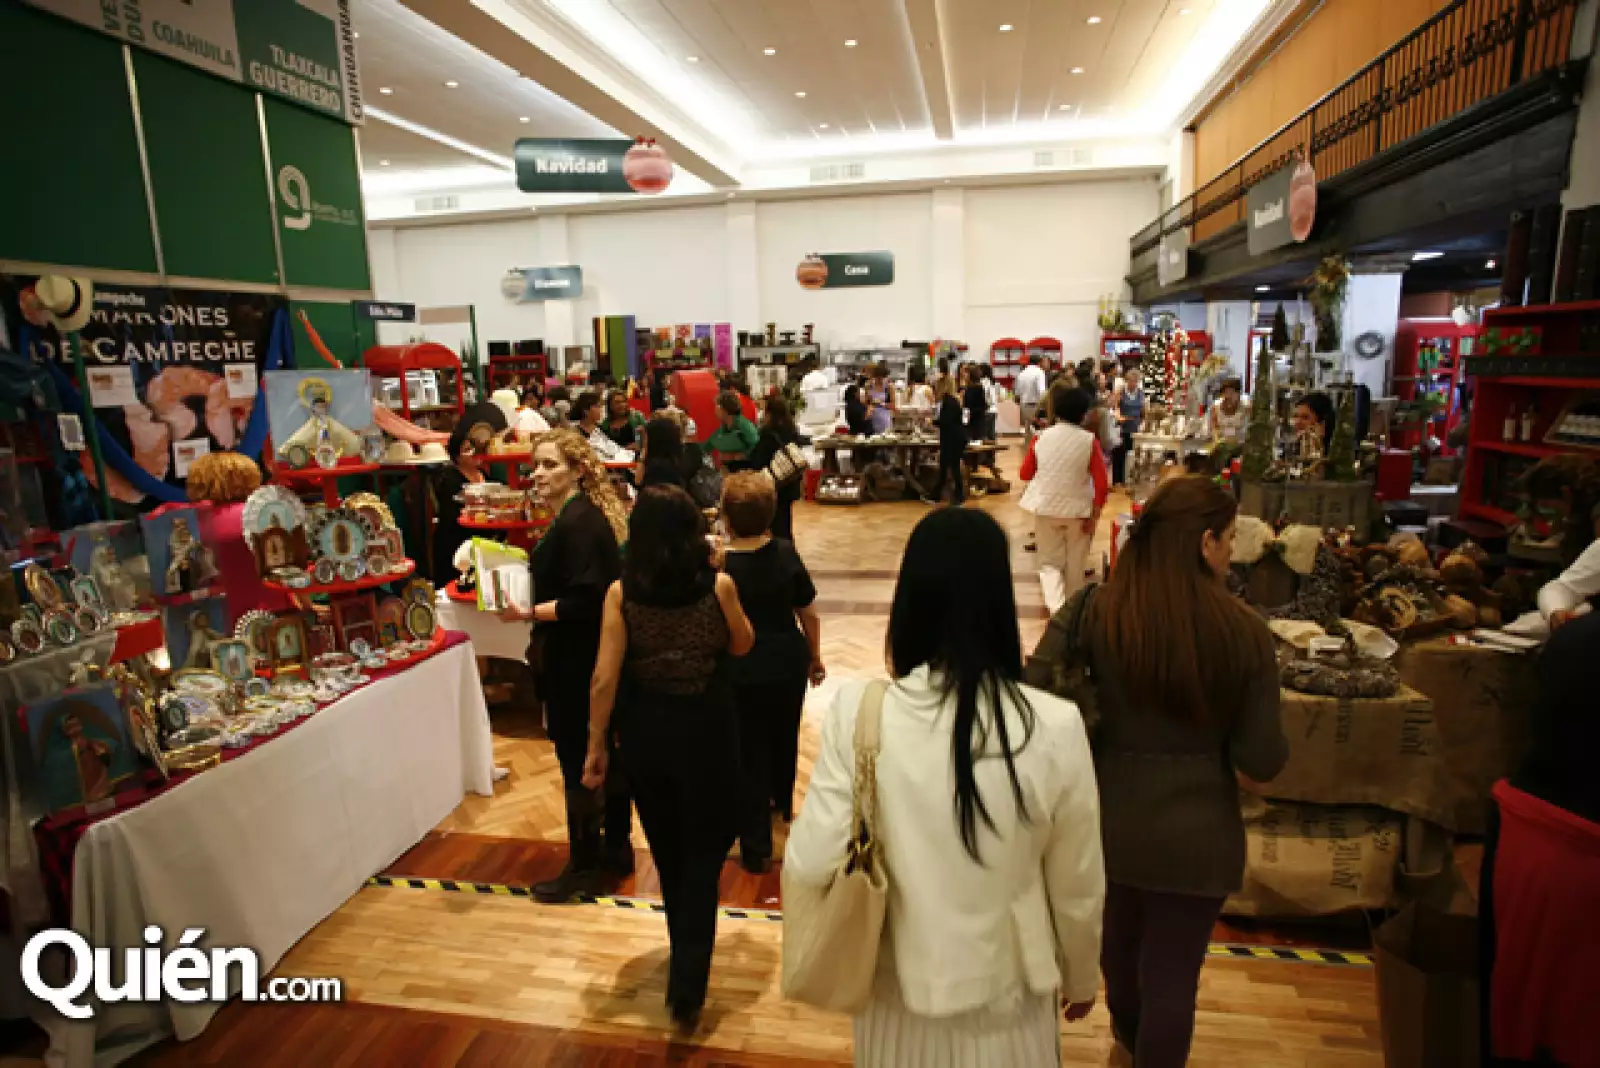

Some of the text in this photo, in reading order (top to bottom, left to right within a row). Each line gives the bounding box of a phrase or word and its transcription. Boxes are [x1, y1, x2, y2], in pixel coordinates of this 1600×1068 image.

[152, 20, 236, 67] COAHUILA
[250, 60, 341, 111] GUERRERO
[535, 157, 609, 174] Navidad
[91, 337, 256, 364] CAMPECHE
